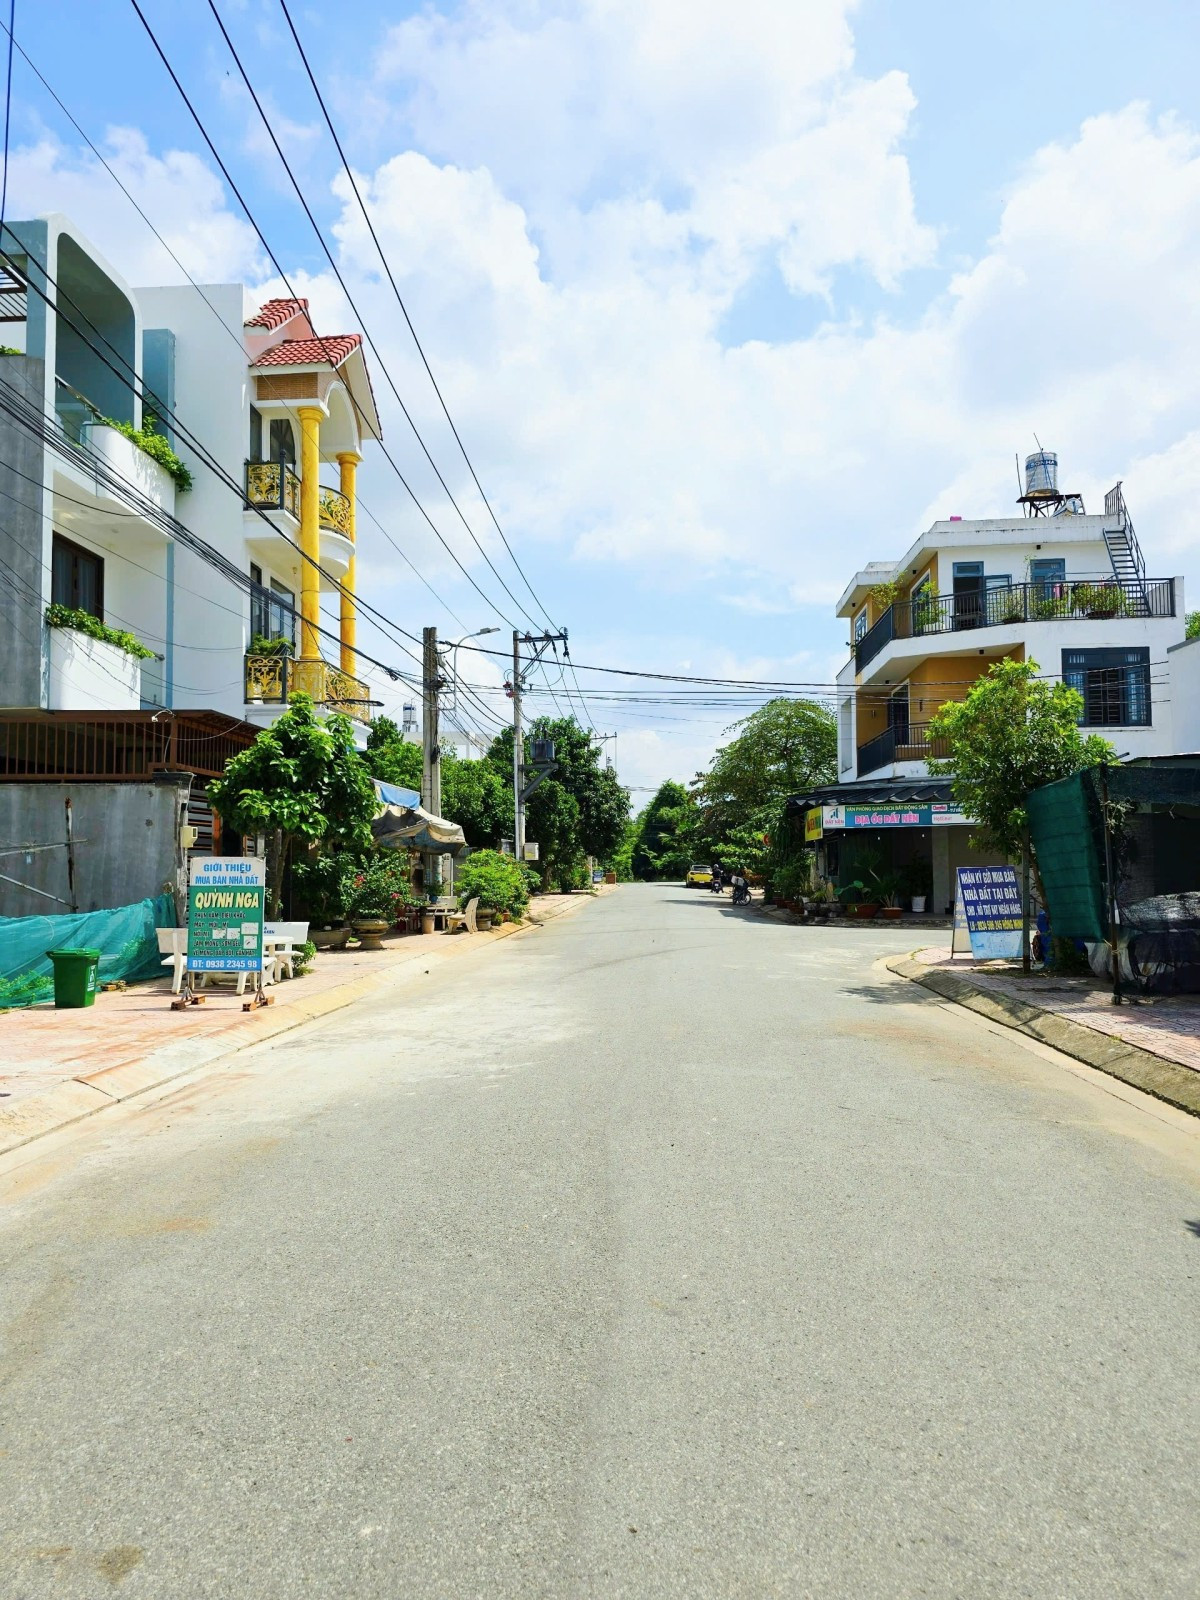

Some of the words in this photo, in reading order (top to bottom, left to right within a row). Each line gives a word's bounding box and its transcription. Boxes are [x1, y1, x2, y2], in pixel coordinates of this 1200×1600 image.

[855, 815, 870, 826] ĐỊA
[871, 812, 883, 824] ỐC
[884, 812, 900, 824] ĐẤT
[901, 811, 919, 823] NỀN
[204, 862, 222, 872] GIỚI
[225, 862, 252, 873] THIỆU
[195, 876, 211, 884] MUA
[213, 875, 227, 884] BÁN
[229, 875, 244, 884] NHÀ
[246, 874, 259, 884] ĐẤT
[975, 870, 982, 884] KÝ
[992, 871, 1004, 883] MUA
[1004, 869, 1016, 883] BÁN
[195, 888, 234, 910] QUỲNH
[235, 892, 259, 908] NGA
[964, 887, 978, 900] NHÀ
[979, 885, 991, 900] ĐẤT
[992, 888, 1004, 902] TẠI
[1004, 885, 1018, 899] ĐÂY
[192, 960, 204, 968] ĐT:
[206, 960, 224, 968] 0938
[227, 960, 245, 968] 2345
[247, 960, 258, 968] 98
